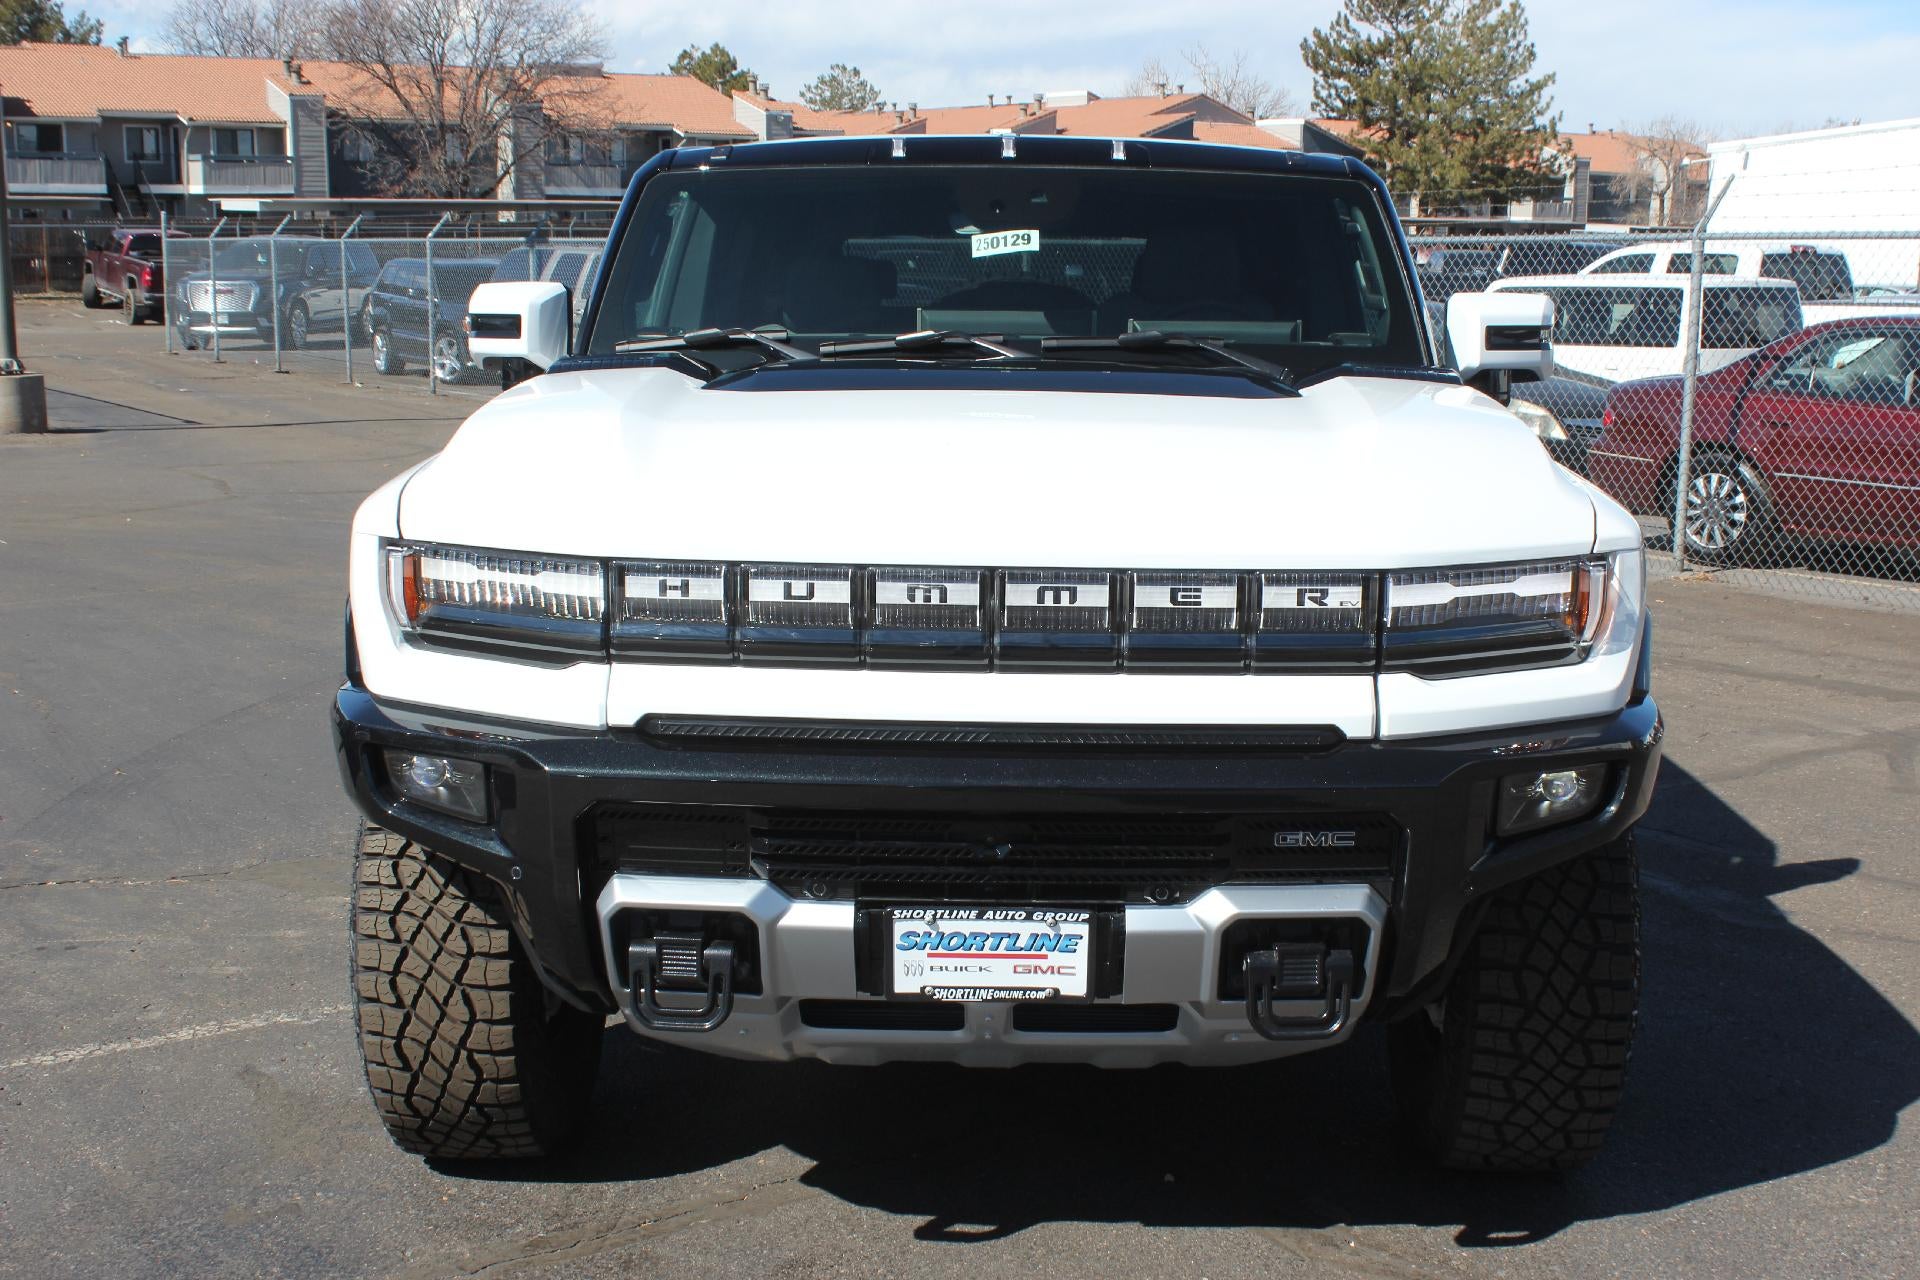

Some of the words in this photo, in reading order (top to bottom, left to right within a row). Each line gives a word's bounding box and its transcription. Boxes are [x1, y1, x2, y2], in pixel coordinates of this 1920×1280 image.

[976, 233, 1032, 251] 250129
[1274, 831, 1355, 847] GMC
[892, 909, 979, 920] SHORTLINE
[983, 910, 1026, 920] AUTO
[1032, 911, 1090, 922] GROUP
[896, 930, 1084, 953] SHORTLINE
[929, 965, 993, 973] BUICK
[1012, 964, 1076, 976] GMC
